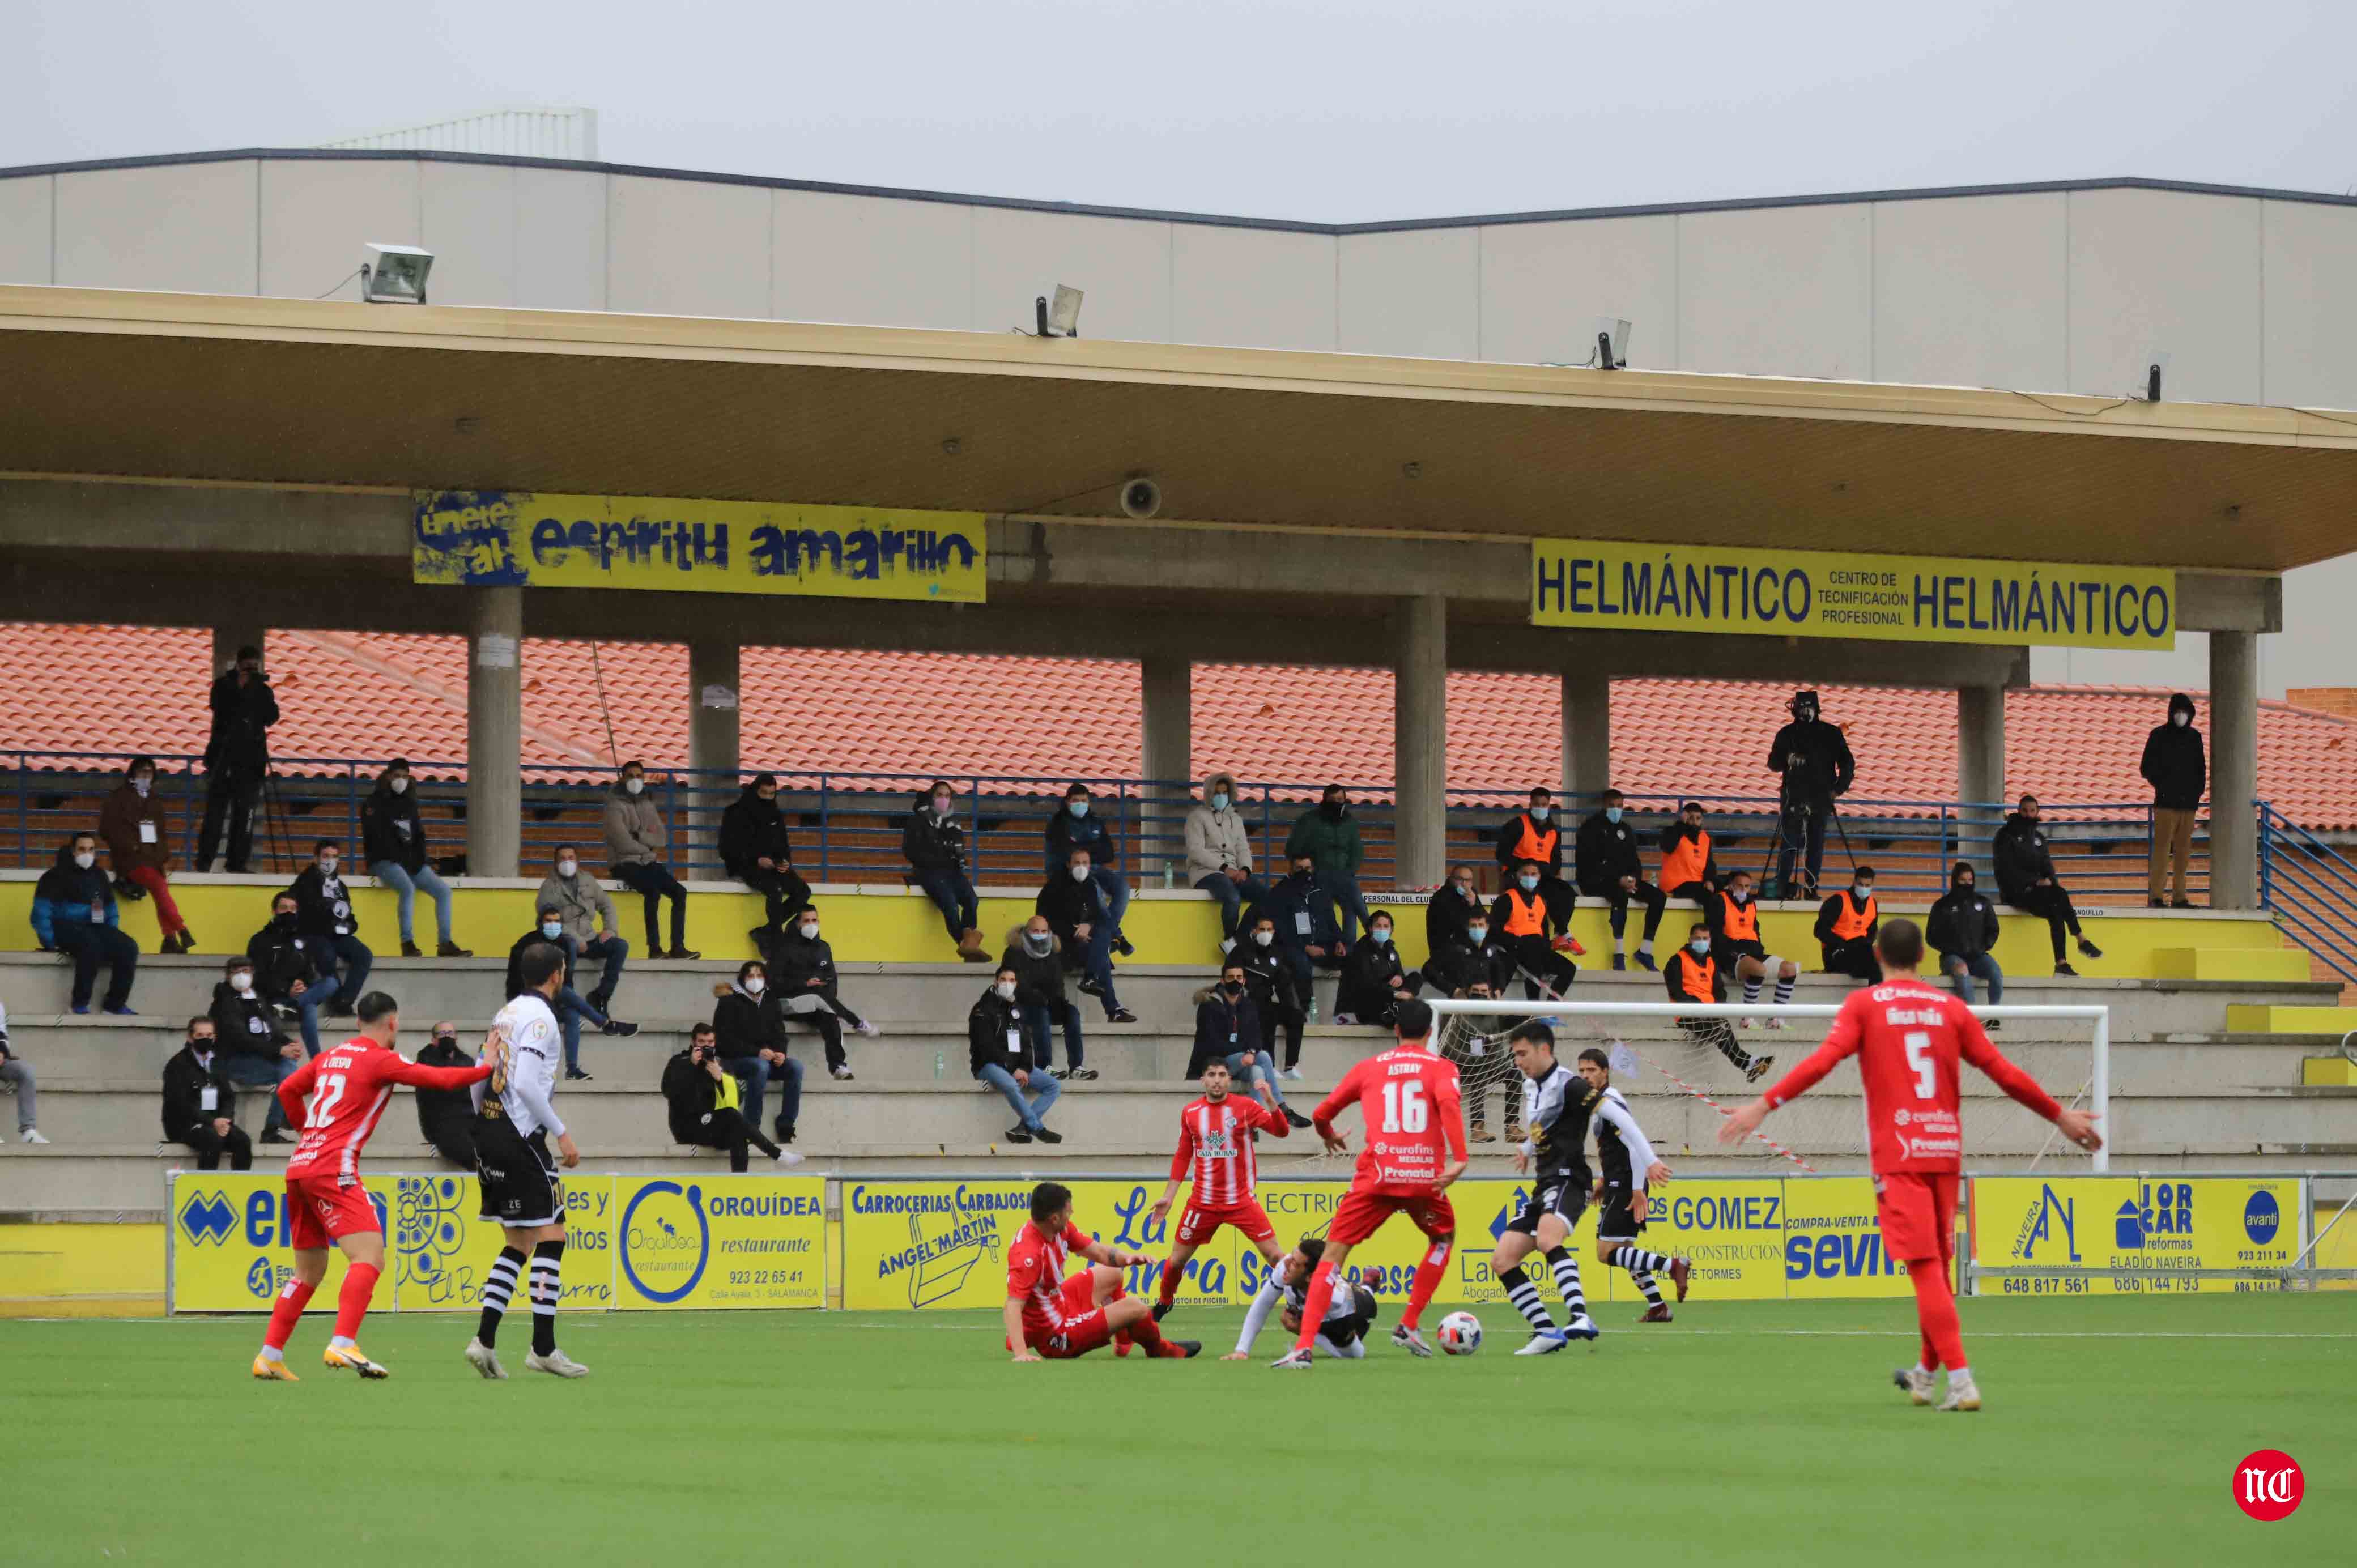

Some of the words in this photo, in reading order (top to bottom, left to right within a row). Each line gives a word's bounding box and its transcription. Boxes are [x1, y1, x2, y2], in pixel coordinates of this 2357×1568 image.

[748, 524, 980, 580] amarillo
[1830, 571, 1877, 585] CENTRO
[1882, 573, 1896, 586] DE
[1538, 553, 1811, 623] HELMÁNTICO
[1818, 590, 1908, 606] TECNIFICACIÓN
[1913, 571, 2169, 638] HELMÁNTICO
[1822, 610, 1904, 625] PROFESIONAL
[1388, 1063, 1423, 1076] ASTRAY
[1904, 1031, 1935, 1099] 5
[304, 1073, 347, 1128] 12
[1381, 1079, 1428, 1133] 16
[1384, 1166, 1435, 1178] Pronatal
[597, 1191, 609, 1217] y
[710, 1192, 821, 1216] ORQUÍDEA
[2139, 1184, 2193, 1209] JOR
[1114, 1186, 1166, 1250] La
[1184, 1210, 1201, 1229] 11
[1673, 1196, 1781, 1230] GOMEZ
[2140, 1209, 2193, 1233] CAR
[2246, 1211, 2277, 1226] avanti
[1785, 1216, 1868, 1230] COMPRA-VENTA
[2011, 1200, 2041, 1259] NAVEIRA
[721, 1237, 811, 1254] restaurante
[2147, 1237, 2193, 1250] reformas
[2156, 1256, 2202, 1268] NAVEIRA
[2238, 1251, 2254, 1260] 923
[2257, 1251, 2272, 1260] 211
[2276, 1250, 2287, 1260] 34
[635, 1260, 695, 1272] restaurante
[1702, 1269, 1741, 1279] TORMES
[729, 1271, 750, 1284] 923
[754, 1271, 768, 1284] 22
[772, 1271, 786, 1283] 65
[790, 1270, 803, 1282] 41
[2114, 1277, 2140, 1292] 686
[2147, 1277, 2170, 1291] 144
[768, 1288, 819, 1297] SALAMANCA
[2003, 1279, 2029, 1293] 648
[2035, 1279, 2060, 1293] 817
[2065, 1278, 2090, 1292] 561
